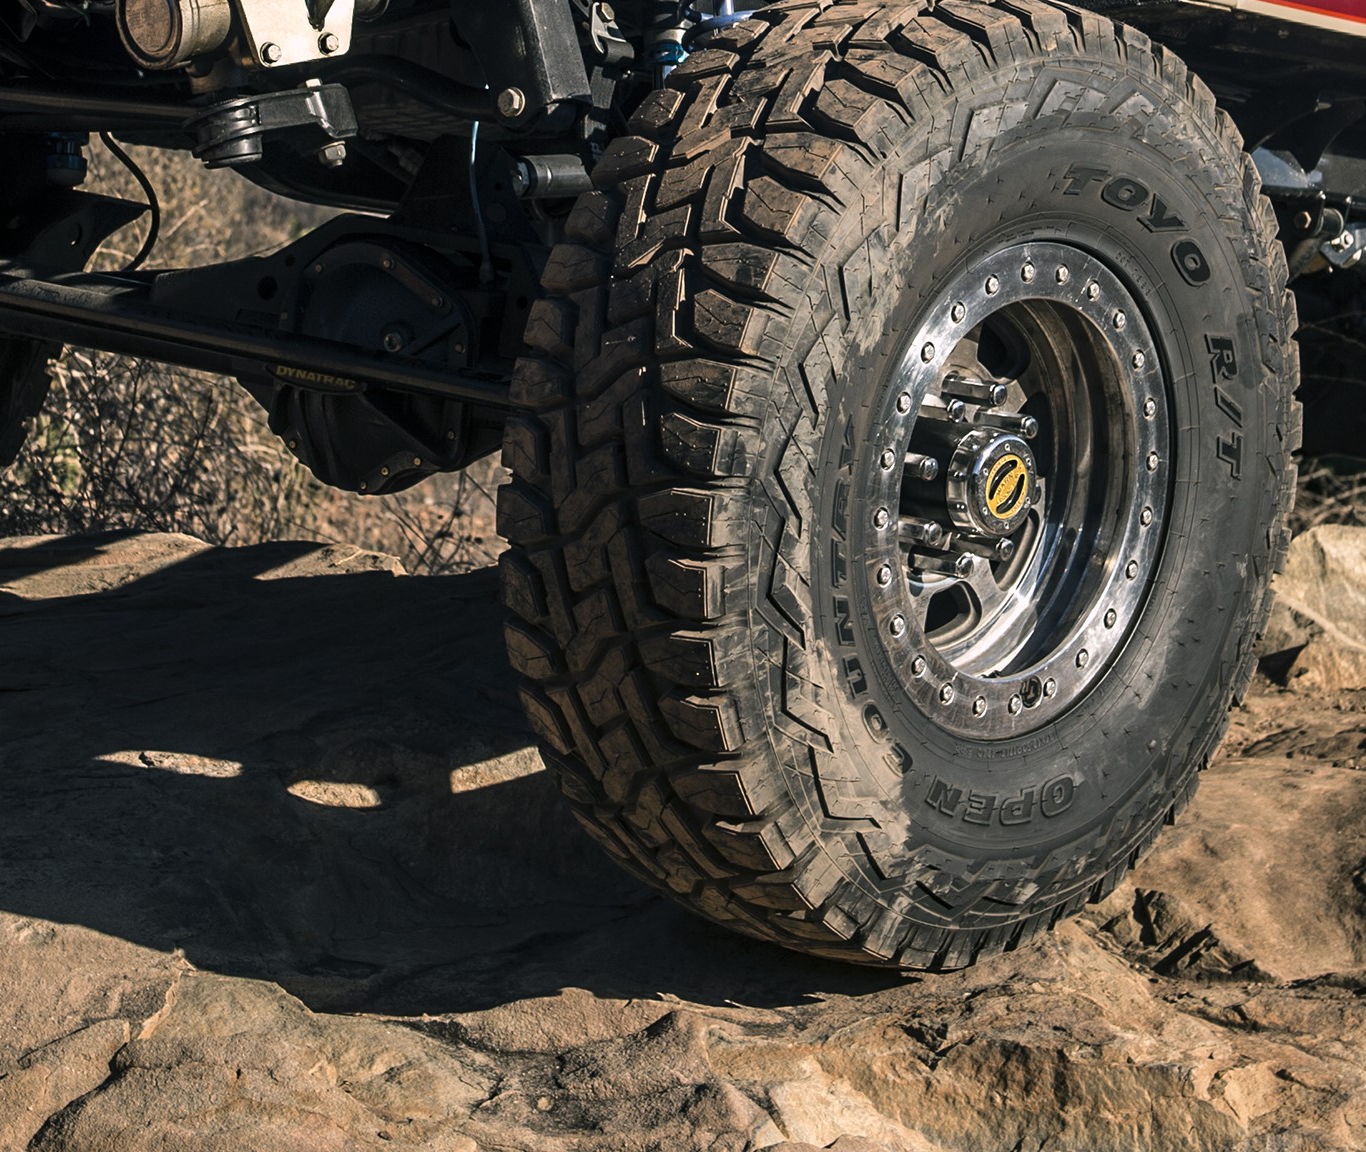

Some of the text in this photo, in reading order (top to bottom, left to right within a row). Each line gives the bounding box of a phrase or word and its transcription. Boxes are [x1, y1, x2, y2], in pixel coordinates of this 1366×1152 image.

[276, 365, 356, 389] DYNATRAC
[1063, 162, 1244, 482] TOYO R/T
[830, 413, 1075, 827] OPEN COUNTRY
